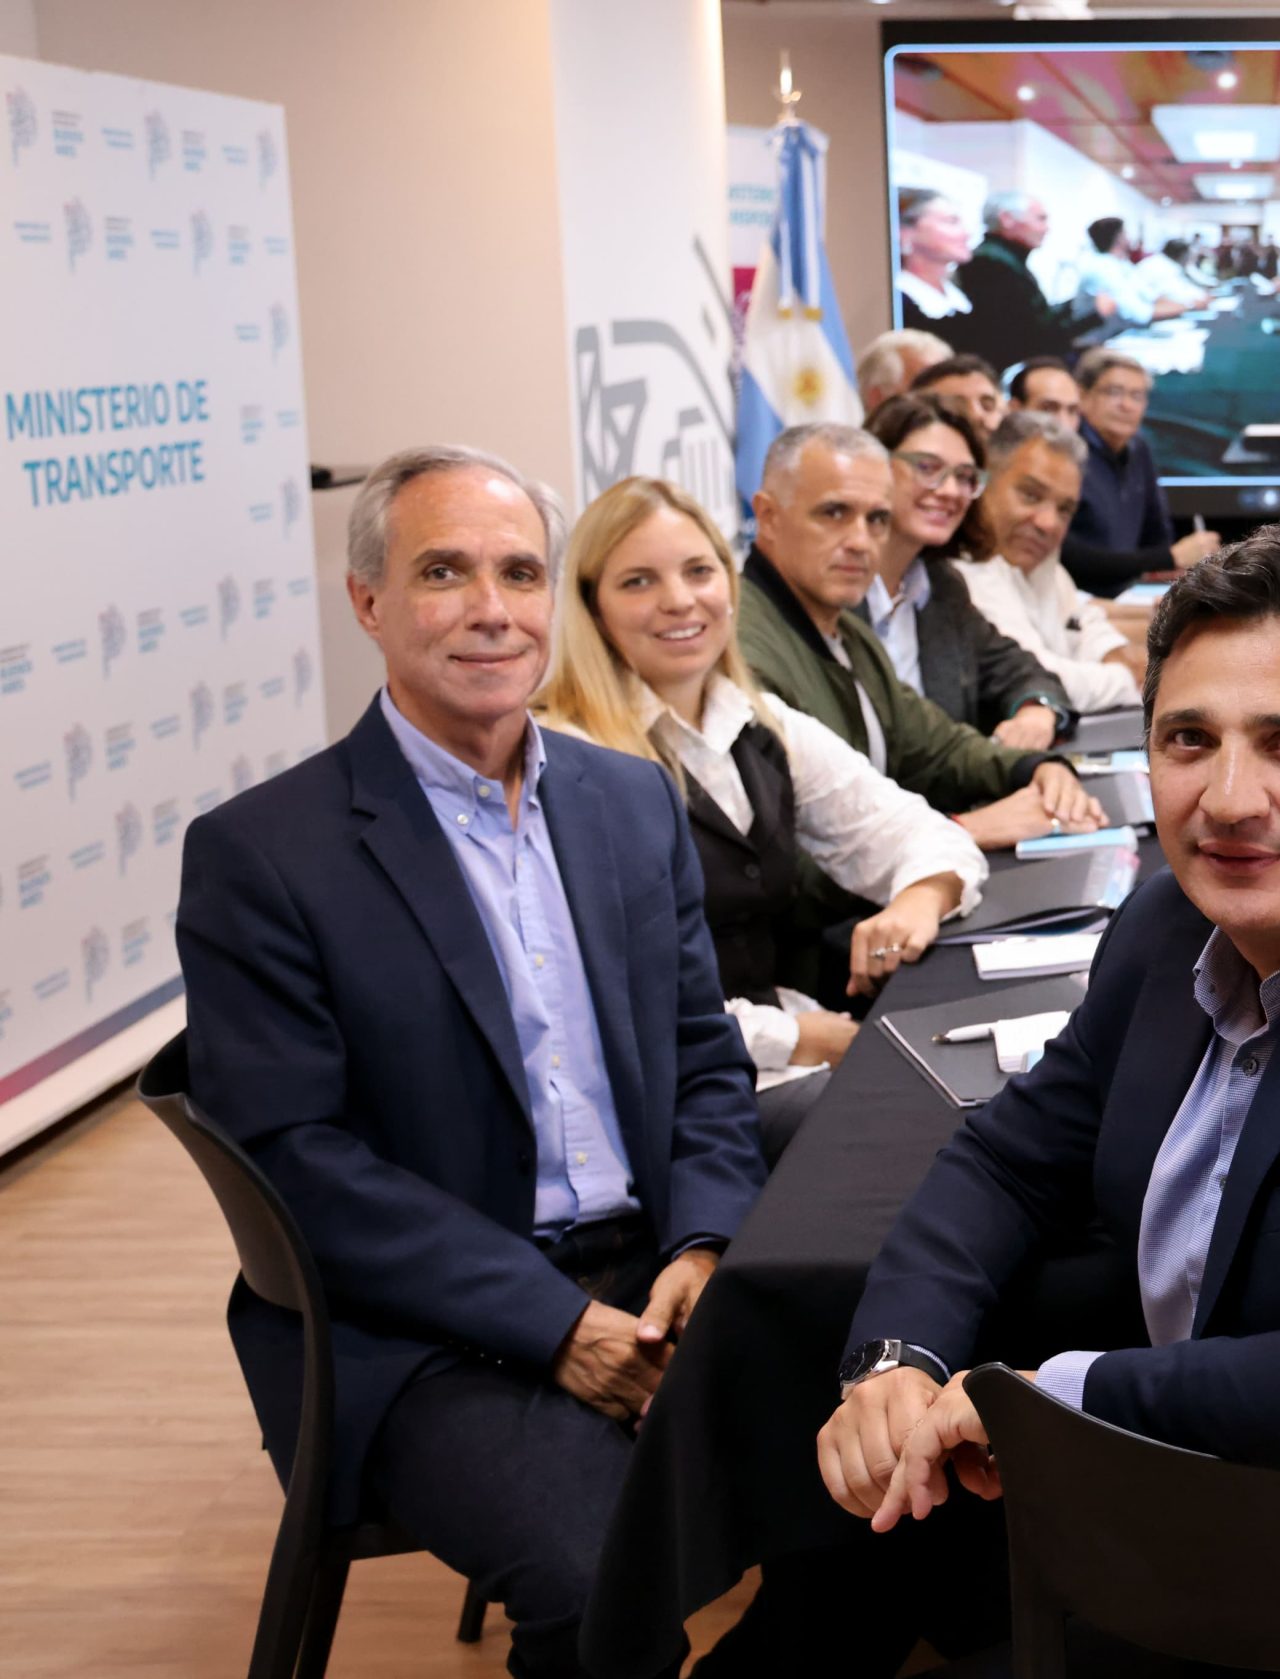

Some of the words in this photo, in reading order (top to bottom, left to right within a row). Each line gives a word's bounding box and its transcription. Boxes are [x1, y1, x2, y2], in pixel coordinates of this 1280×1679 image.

[5, 383, 171, 441] MINISTERIO
[176, 379, 209, 424] DE
[22, 439, 206, 508] TRANSPORTE
